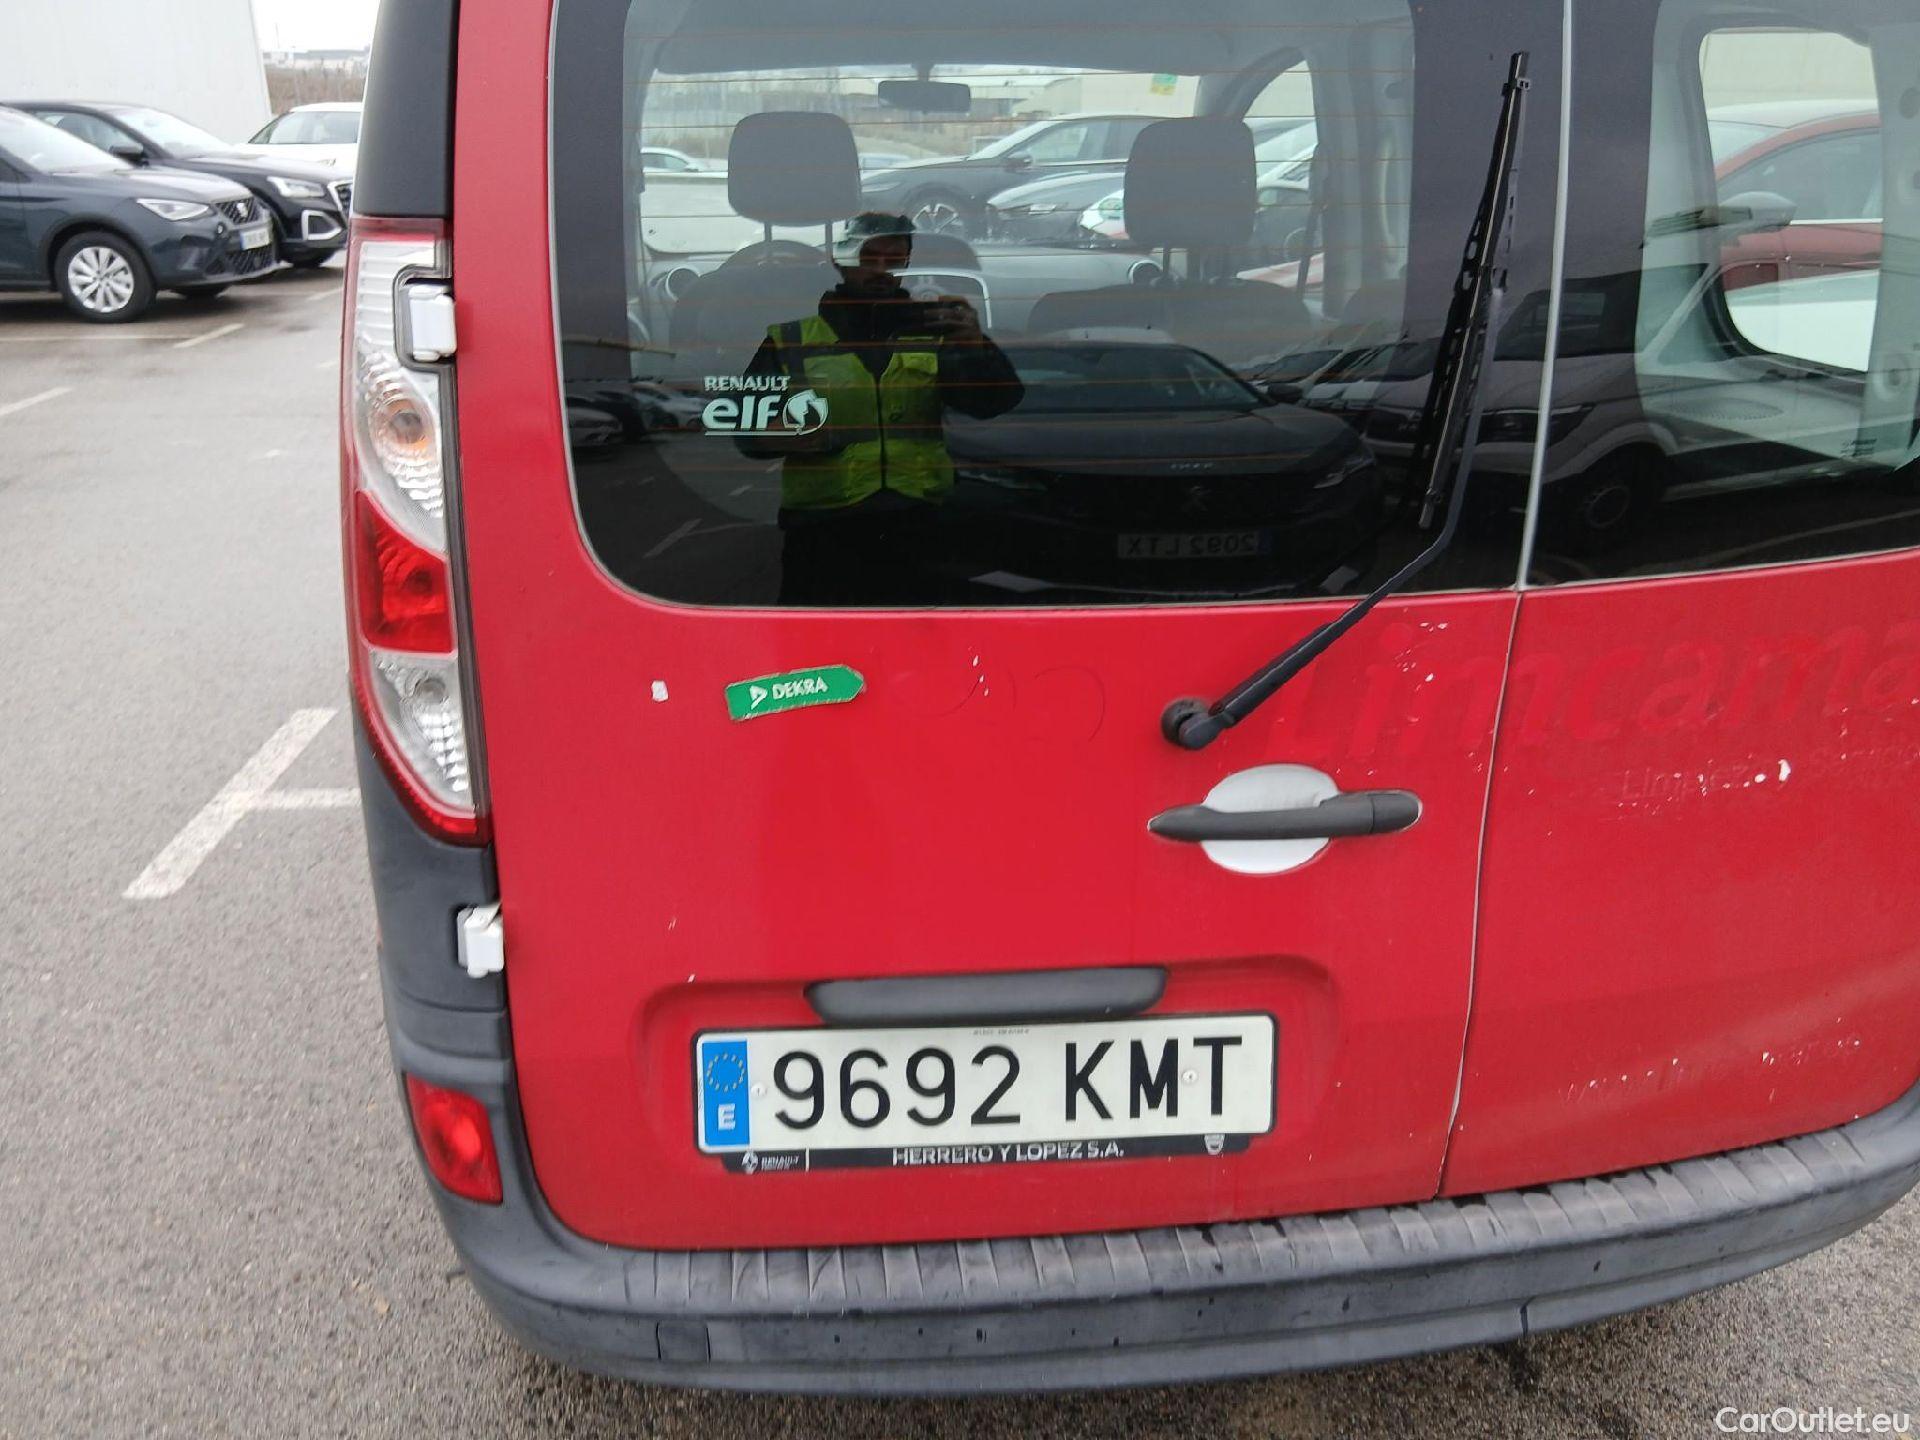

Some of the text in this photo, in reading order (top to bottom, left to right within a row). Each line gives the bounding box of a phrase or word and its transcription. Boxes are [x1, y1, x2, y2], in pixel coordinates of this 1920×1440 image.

[703, 375, 791, 391] RENAULT
[702, 394, 781, 430] elf
[772, 676, 829, 700] DEKRA
[773, 1045, 1021, 1130] 9692
[1065, 1036, 1242, 1121] KMT
[718, 1103, 735, 1130] E
[892, 1140, 1125, 1166] HERRERO Y LOPEZ S.A.
